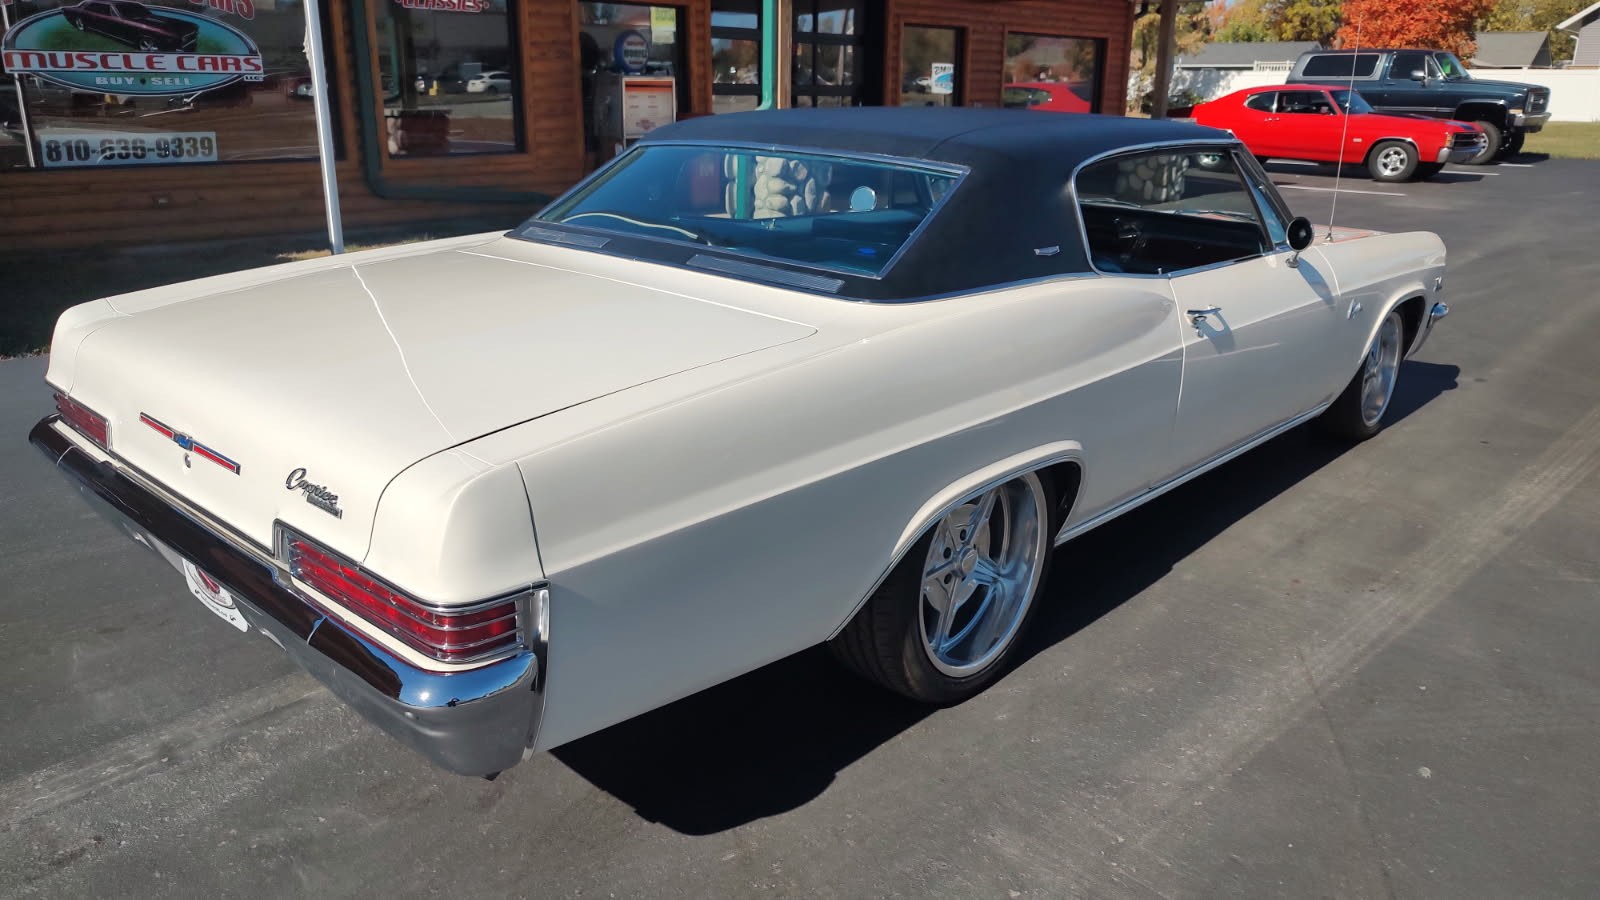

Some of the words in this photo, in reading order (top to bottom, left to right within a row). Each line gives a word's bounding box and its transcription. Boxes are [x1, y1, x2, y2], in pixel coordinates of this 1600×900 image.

[4, 51, 167, 70] MUSCLE
[176, 54, 262, 72] CARS
[95, 76, 135, 85] BUY
[151, 77, 192, 86] SELL
[45, 136, 213, 162] 810-636-9339
[286, 468, 338, 505] Caprice
